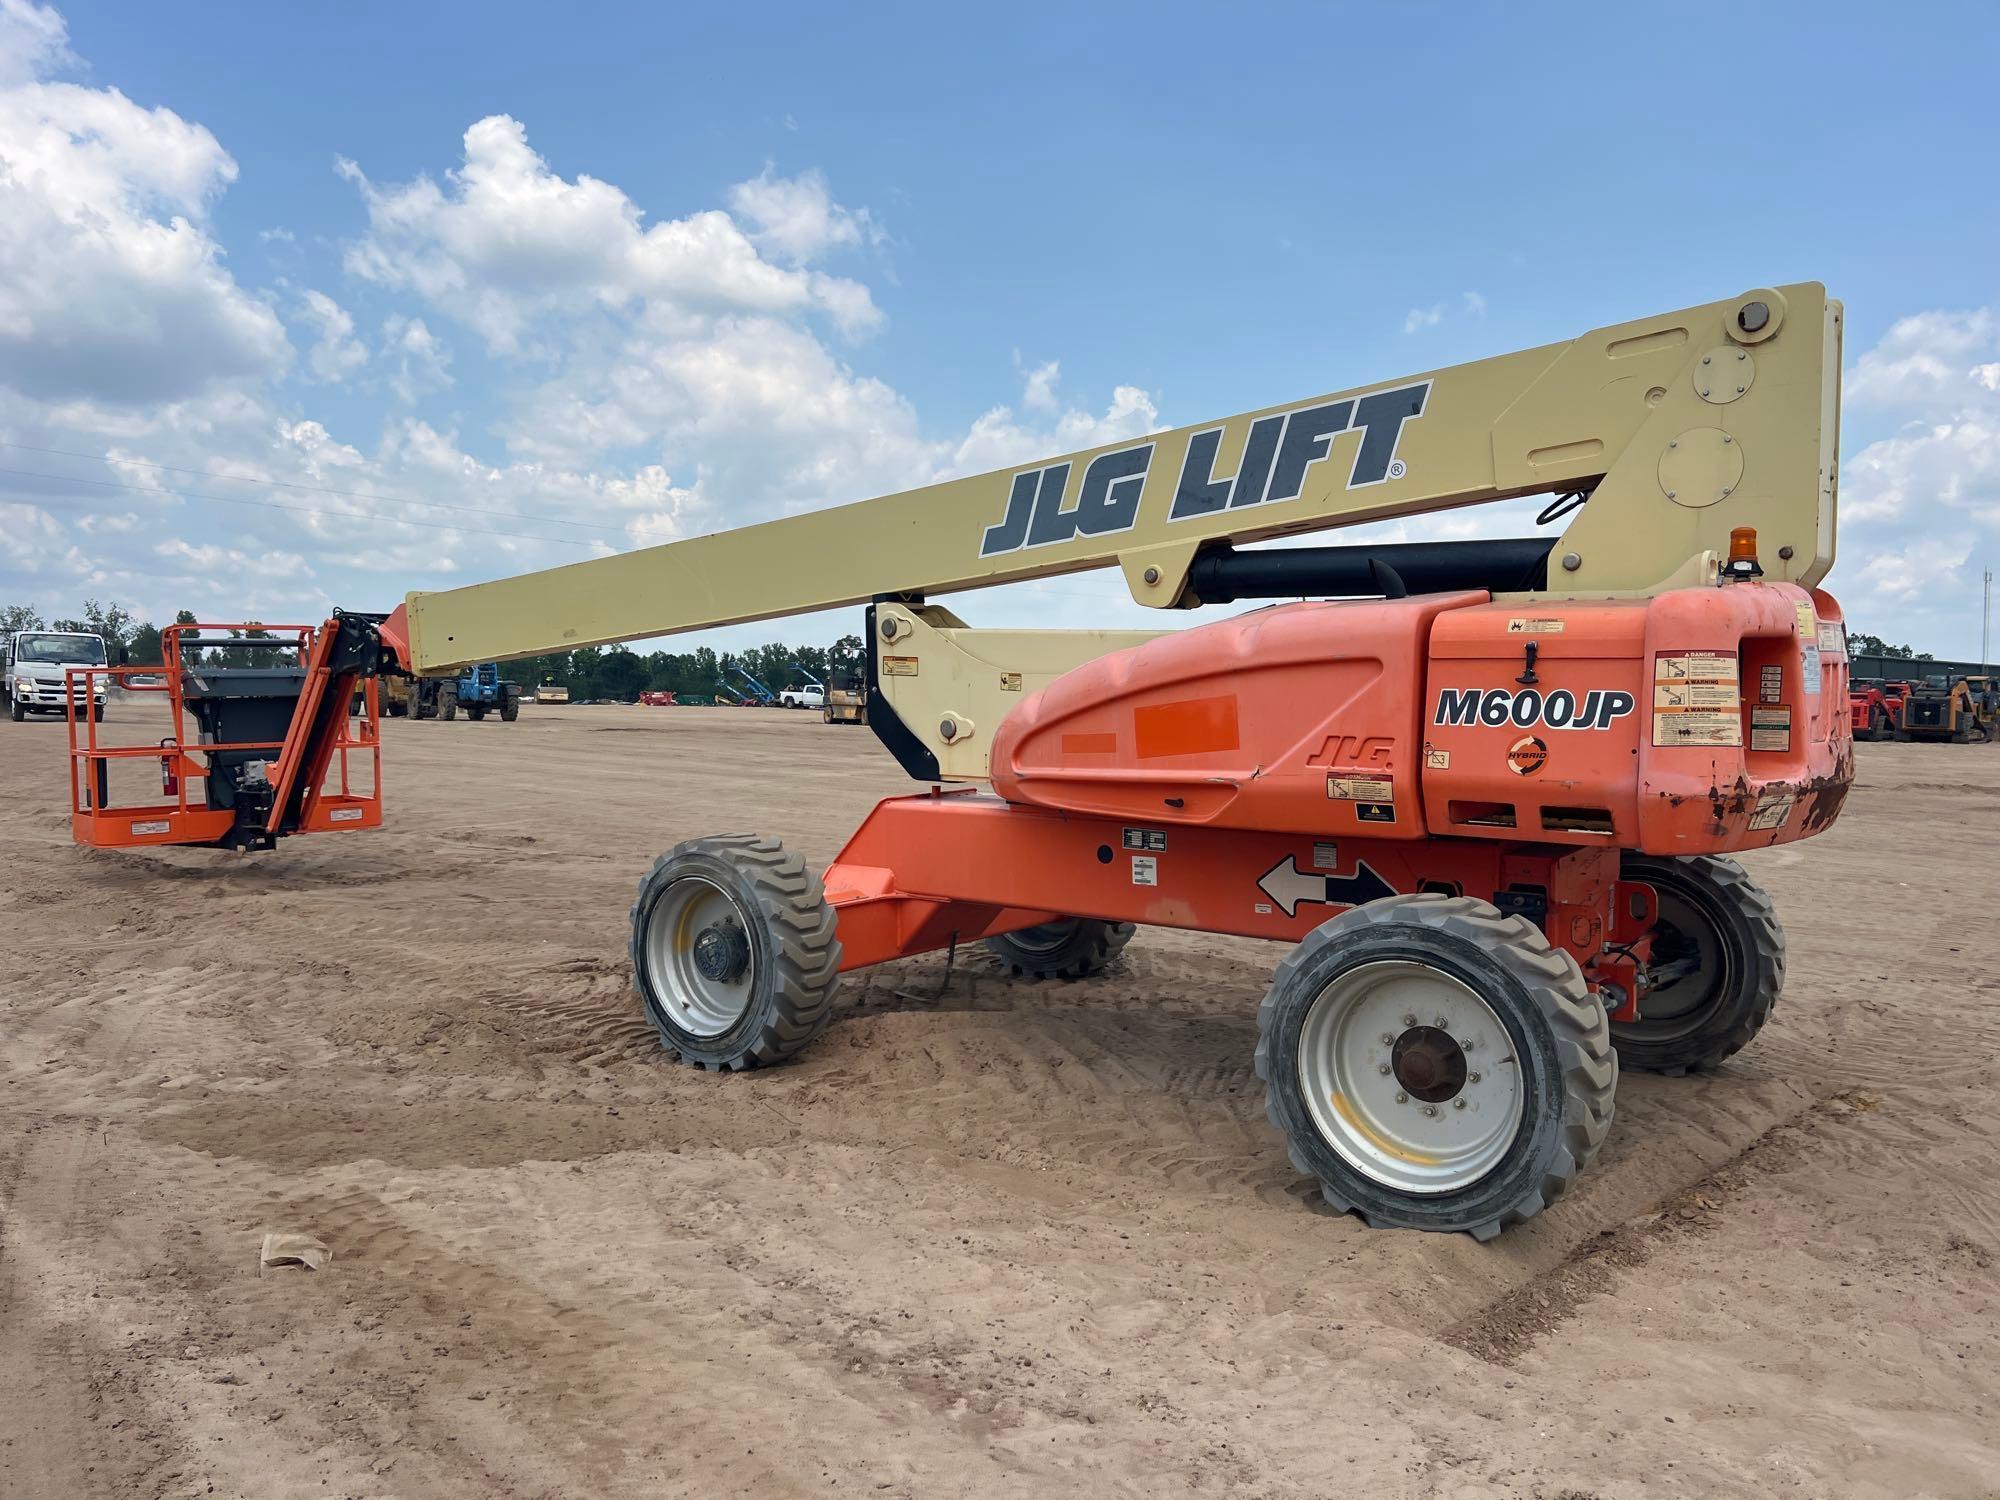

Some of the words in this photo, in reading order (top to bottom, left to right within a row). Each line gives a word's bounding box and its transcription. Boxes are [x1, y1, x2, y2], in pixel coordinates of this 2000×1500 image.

[978, 441, 1156, 559] JLG
[1167, 378, 1435, 523] LIFT
[1434, 688, 1634, 730] M600JP
